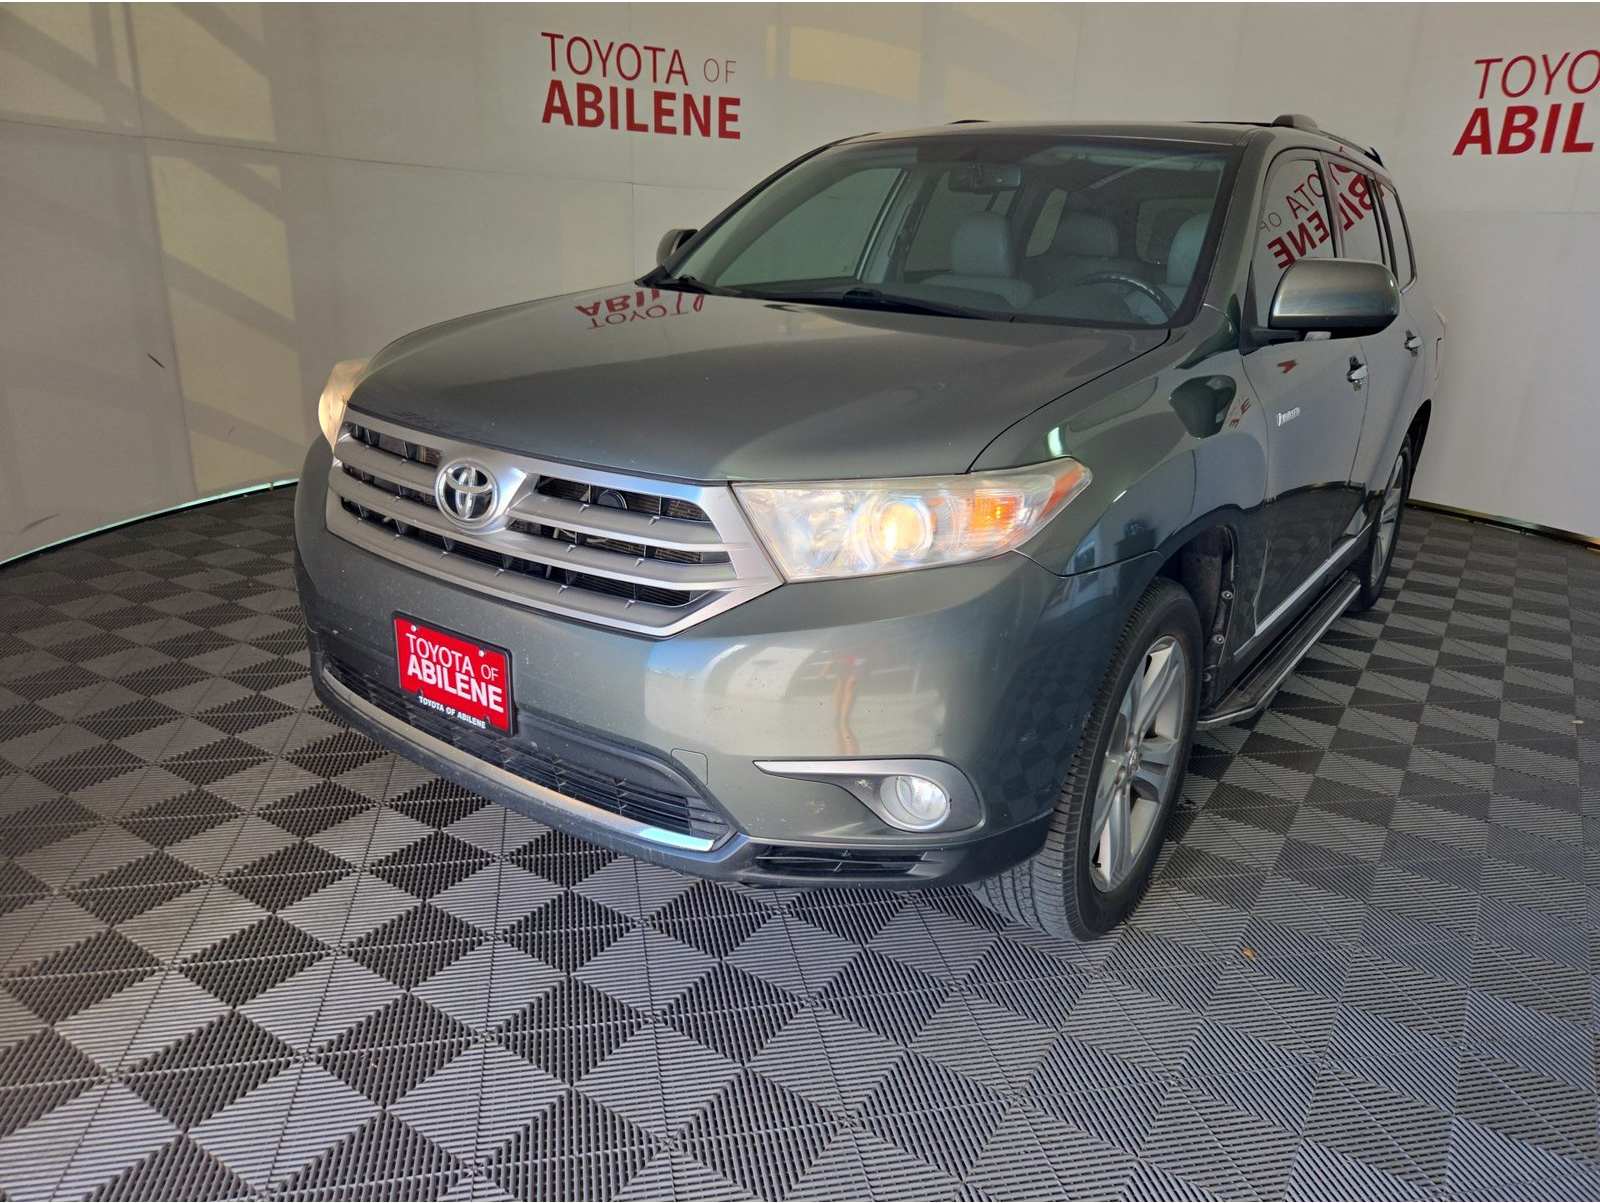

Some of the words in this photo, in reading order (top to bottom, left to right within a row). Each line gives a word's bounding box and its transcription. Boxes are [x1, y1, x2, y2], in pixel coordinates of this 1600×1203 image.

[541, 32, 688, 86] TOYOTA
[703, 58, 737, 84] OF
[541, 79, 741, 140] ABILENE
[1452, 102, 1595, 156] ABIL
[405, 632, 475, 678] TOYOTA
[480, 664, 499, 682] OF
[407, 654, 504, 713] ABILENE
[418, 695, 445, 712] TOYOTA
[446, 707, 456, 716] OF
[457, 711, 487, 729] ABILENE
